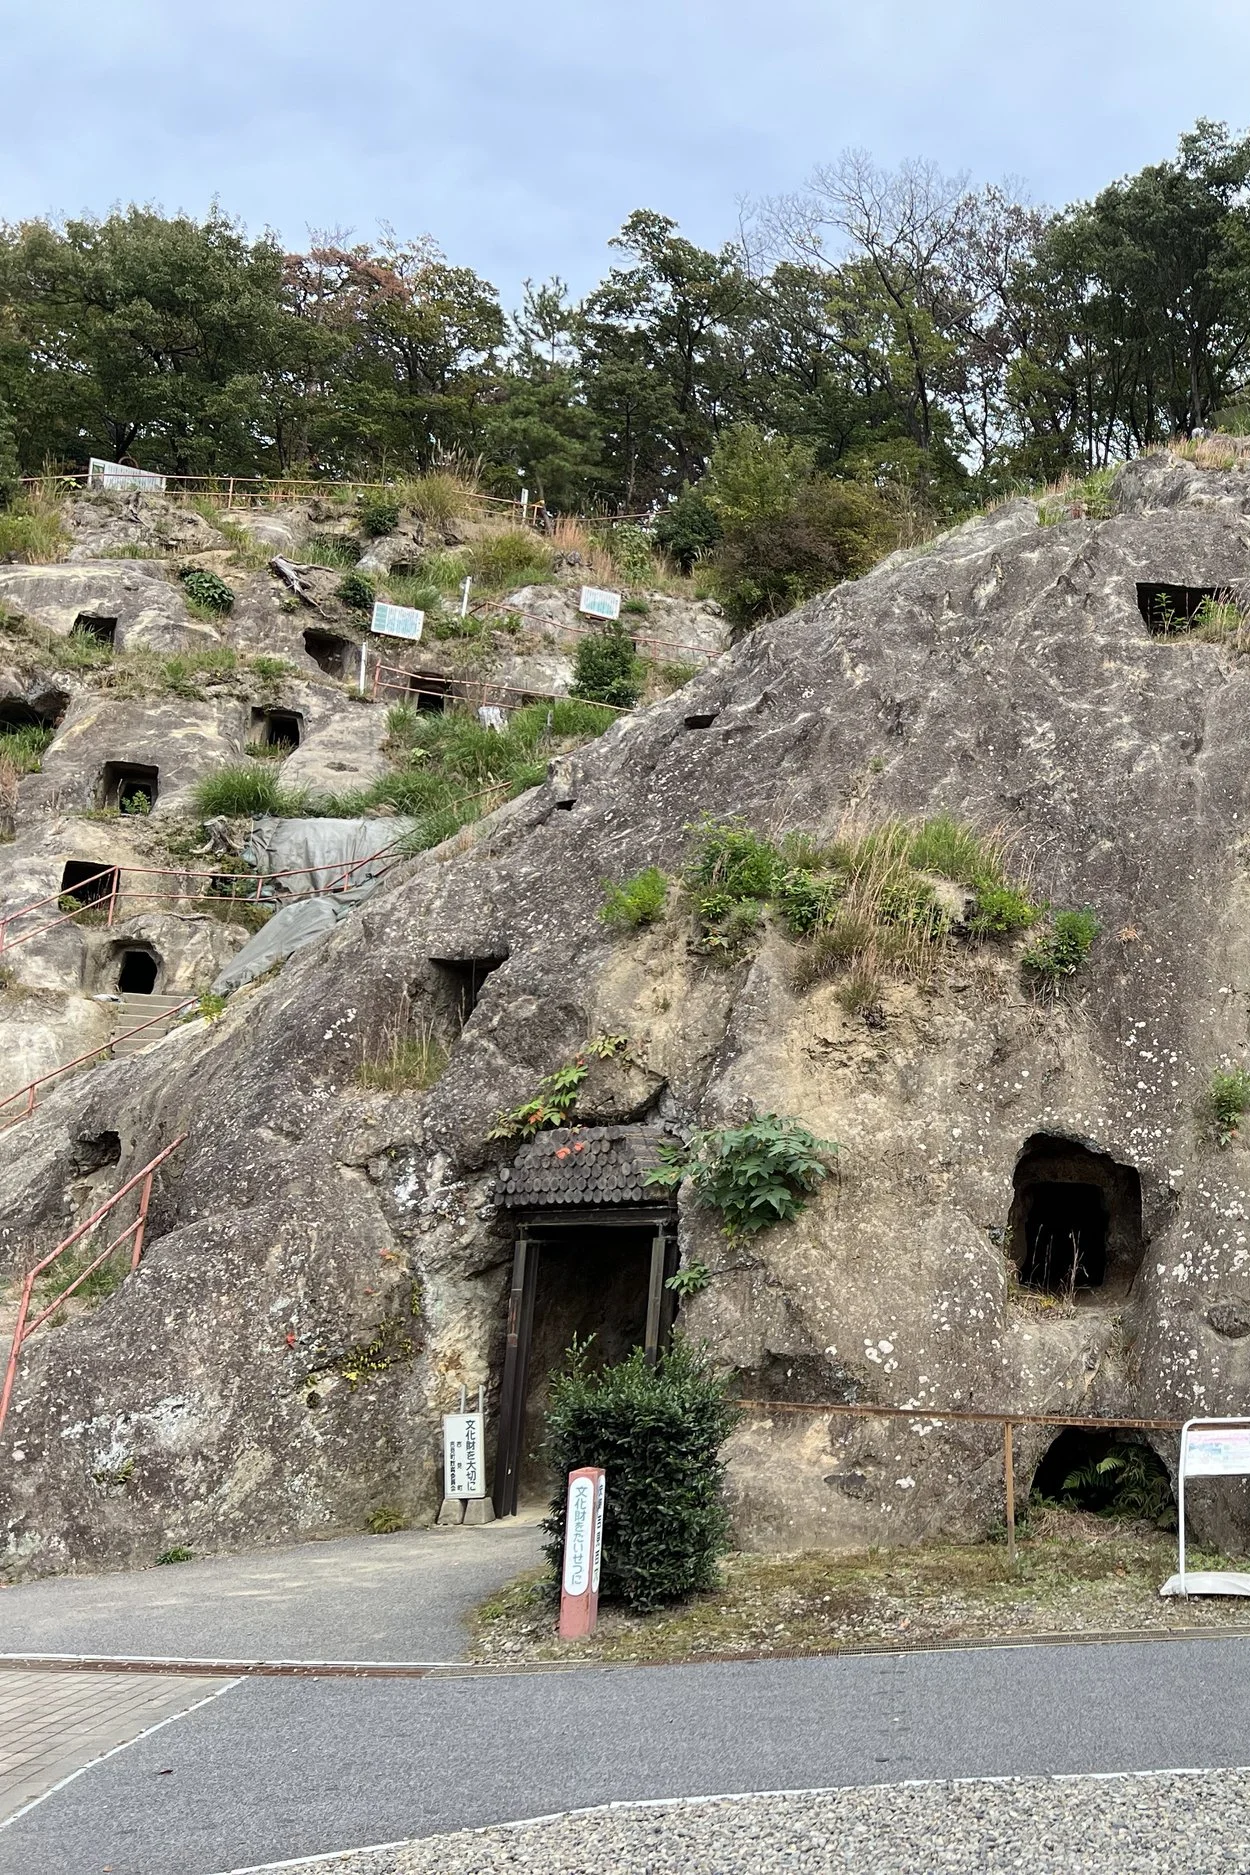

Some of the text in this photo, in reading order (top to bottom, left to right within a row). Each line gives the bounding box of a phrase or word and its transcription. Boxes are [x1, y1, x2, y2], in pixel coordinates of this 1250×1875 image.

[465, 1420, 477, 1491] 文化財を大切に
[571, 1486, 588, 1585] 文化財をたいせつに
